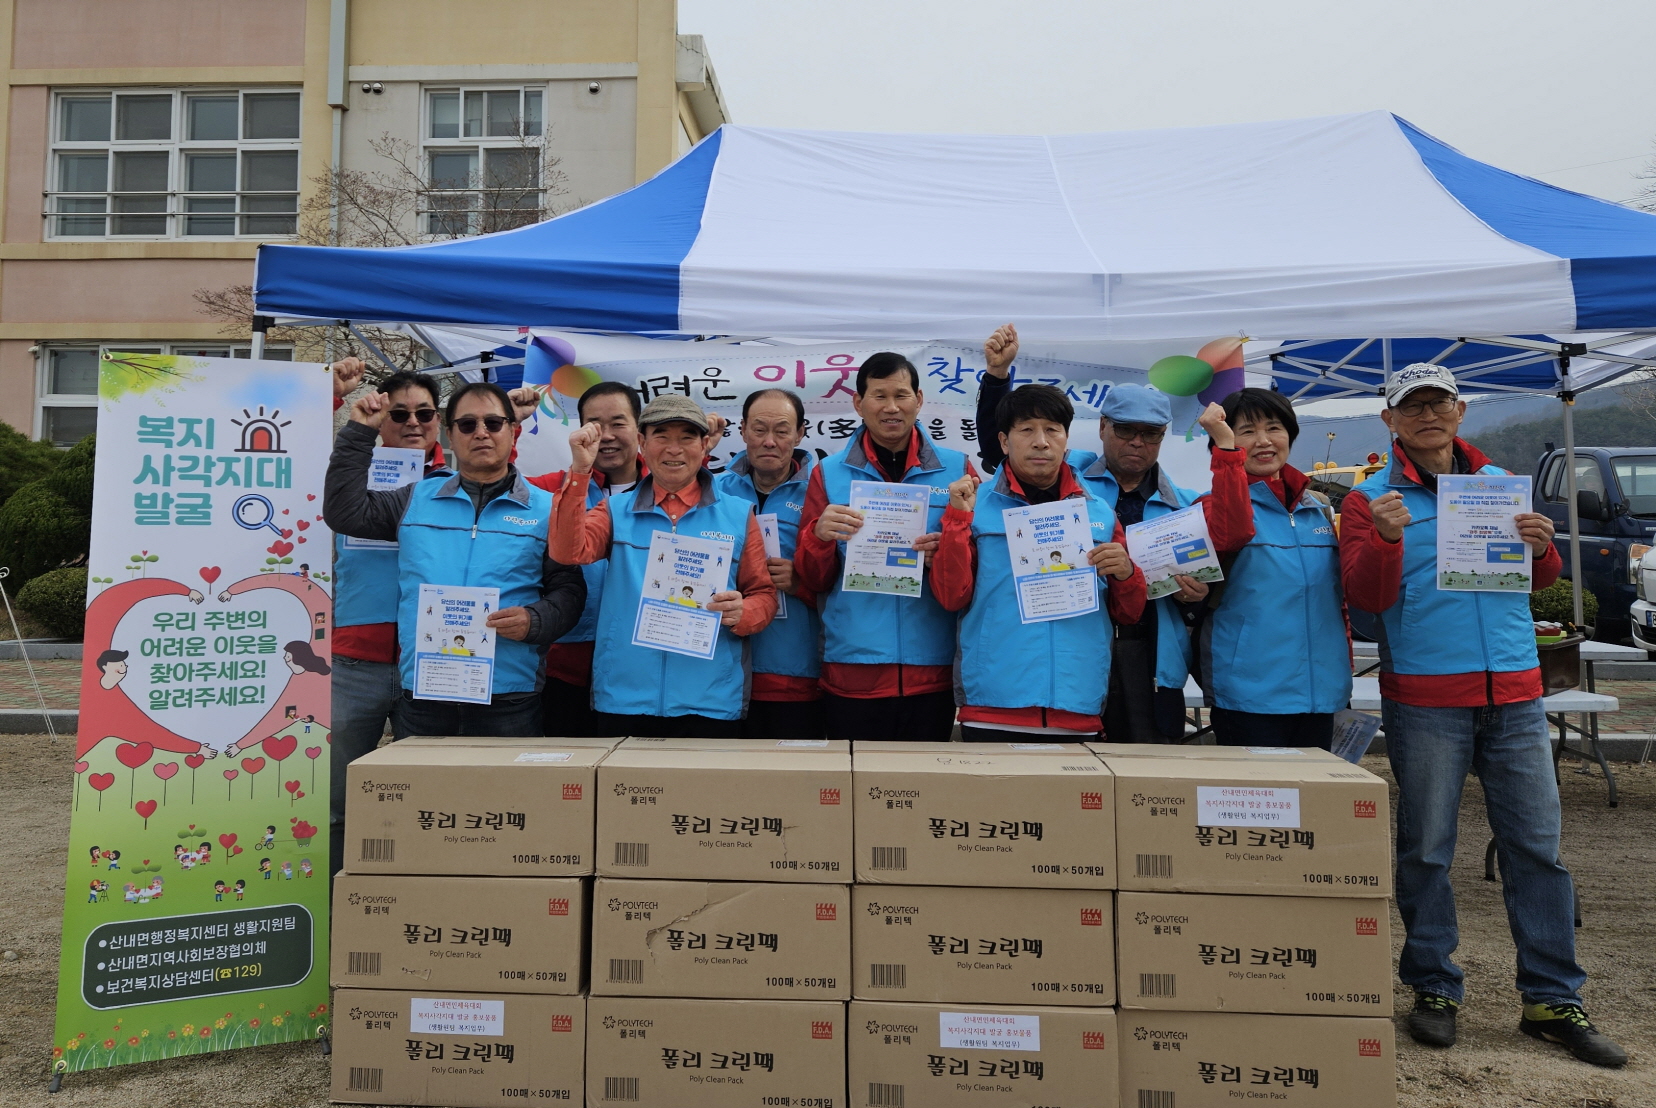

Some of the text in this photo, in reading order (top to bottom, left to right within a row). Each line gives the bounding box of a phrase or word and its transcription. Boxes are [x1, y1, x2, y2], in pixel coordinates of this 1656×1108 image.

[754, 354, 859, 398] 이웃
[137, 415, 215, 450] 복지
[133, 455, 292, 489] 사각지대
[134, 492, 212, 526] 발굴
[153, 610, 267, 632] 우리 주변의
[140, 635, 277, 658] 어려운 이웃을
[150, 661, 265, 684] 찾아주세요!
[149, 686, 265, 710] 알려주세요!
[378, 793, 403, 801] 폴리텍
[631, 796, 656, 805] 폴리텍
[886, 800, 913, 809] 폴리텍
[1206, 800, 1244, 808] 복지사각지대
[1150, 807, 1178, 817] 폴리텍
[417, 811, 525, 830] 폴리 크린팩
[671, 814, 782, 836] 폴리 크린팩
[929, 818, 1043, 840] 폴리 크린팩
[444, 836, 458, 844] Poly
[1195, 826, 1314, 849] 폴리 크린팩
[1226, 853, 1241, 861] Poly
[364, 906, 389, 915] 폴리텍
[883, 906, 918, 914] POLYTECH
[625, 912, 651, 921] 폴리텍
[885, 916, 911, 925] 폴리텍
[109, 916, 296, 950] 산내면행정복지센터 생활지원팀
[403, 924, 511, 946] 폴리 크린팩
[1153, 926, 1181, 935] 폴리텍
[667, 929, 778, 952] 폴리 크린팩
[928, 935, 1042, 958] 폴리 크린팩
[108, 941, 267, 972] 산내면지역사회보장협의체
[430, 950, 443, 958] Poly
[1198, 944, 1316, 967] 폴리 크린팩
[695, 957, 709, 965] Poly
[957, 962, 972, 970] Poly
[1229, 971, 1244, 979] Poly
[365, 1021, 391, 1030] 폴리텍
[881, 1025, 917, 1033] POLYTECH
[620, 1029, 646, 1039] 폴리텍
[1150, 1031, 1187, 1039] POLYTECH
[884, 1035, 910, 1044] 폴리텍
[405, 1039, 514, 1063] 폴리 크린팩
[1153, 1041, 1181, 1051] 폴리텍
[661, 1048, 773, 1072] 폴리 크린팩
[927, 1054, 1043, 1080] 폴리 크린팩
[1198, 1062, 1318, 1088] 폴리 크린팩
[957, 1084, 971, 1092] Poly
[1229, 1090, 1244, 1099] Poly
